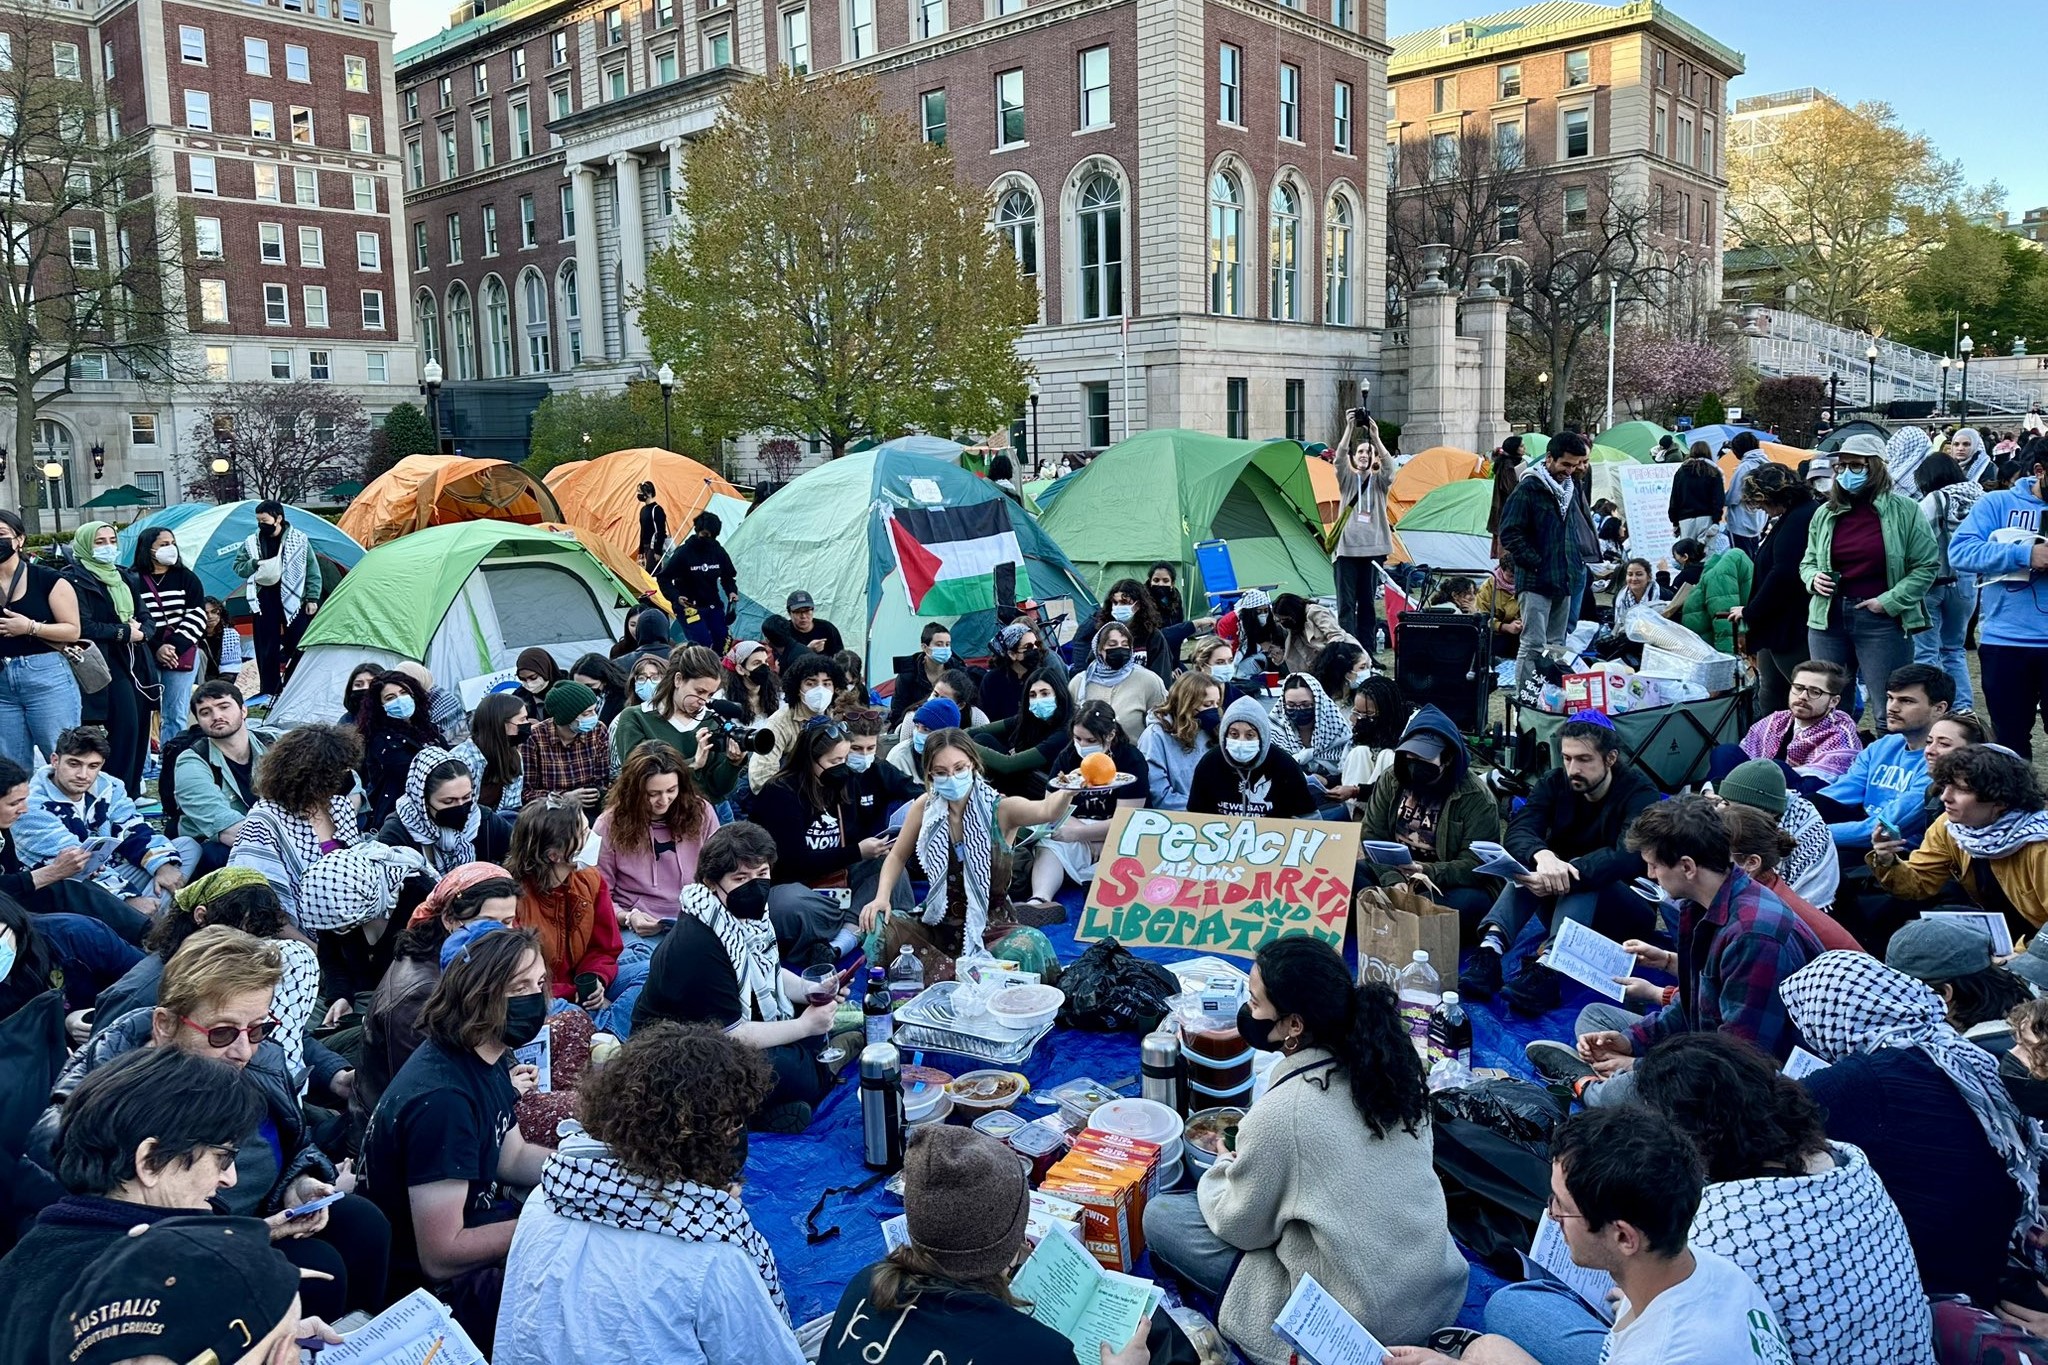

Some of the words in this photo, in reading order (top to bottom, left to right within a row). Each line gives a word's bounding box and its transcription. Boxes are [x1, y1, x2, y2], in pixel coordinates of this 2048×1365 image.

[1217, 801, 1245, 811] JEWS
[805, 836, 841, 850] NOW
[1151, 860, 1245, 884] MEANS
[1240, 898, 1311, 921] AND
[73, 1298, 160, 1338] AUSTRALIS
[69, 1324, 120, 1361] EXPEDITION
[121, 1322, 165, 1336] CRUISES
